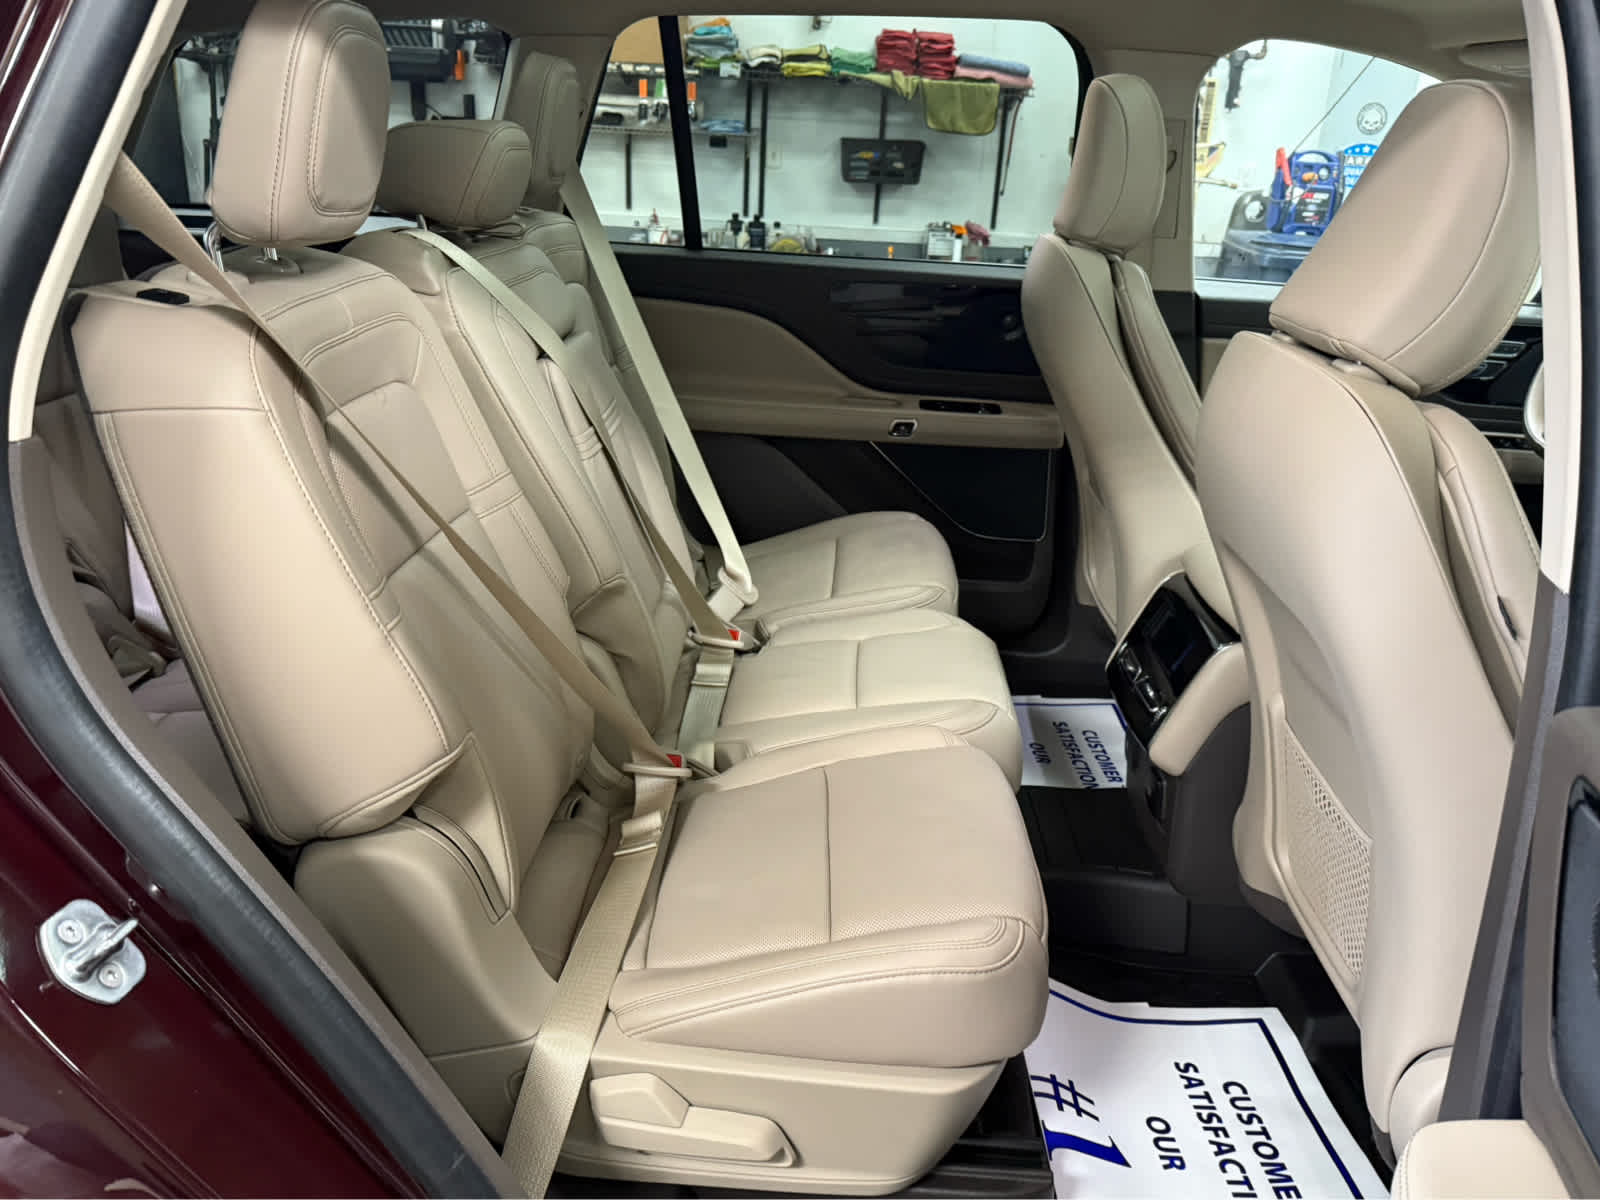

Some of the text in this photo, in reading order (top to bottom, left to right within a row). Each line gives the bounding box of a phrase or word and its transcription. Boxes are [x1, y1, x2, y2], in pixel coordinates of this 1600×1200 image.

[1029, 742, 1051, 764] OUR
[1082, 730, 1123, 783] CUSTOMER
[1030, 1073, 1132, 1168] #1
[1145, 1116, 1186, 1170] OUR
[1174, 1061, 1258, 1199] SATISFACTI
[1222, 1080, 1302, 1200] CUSTOME
